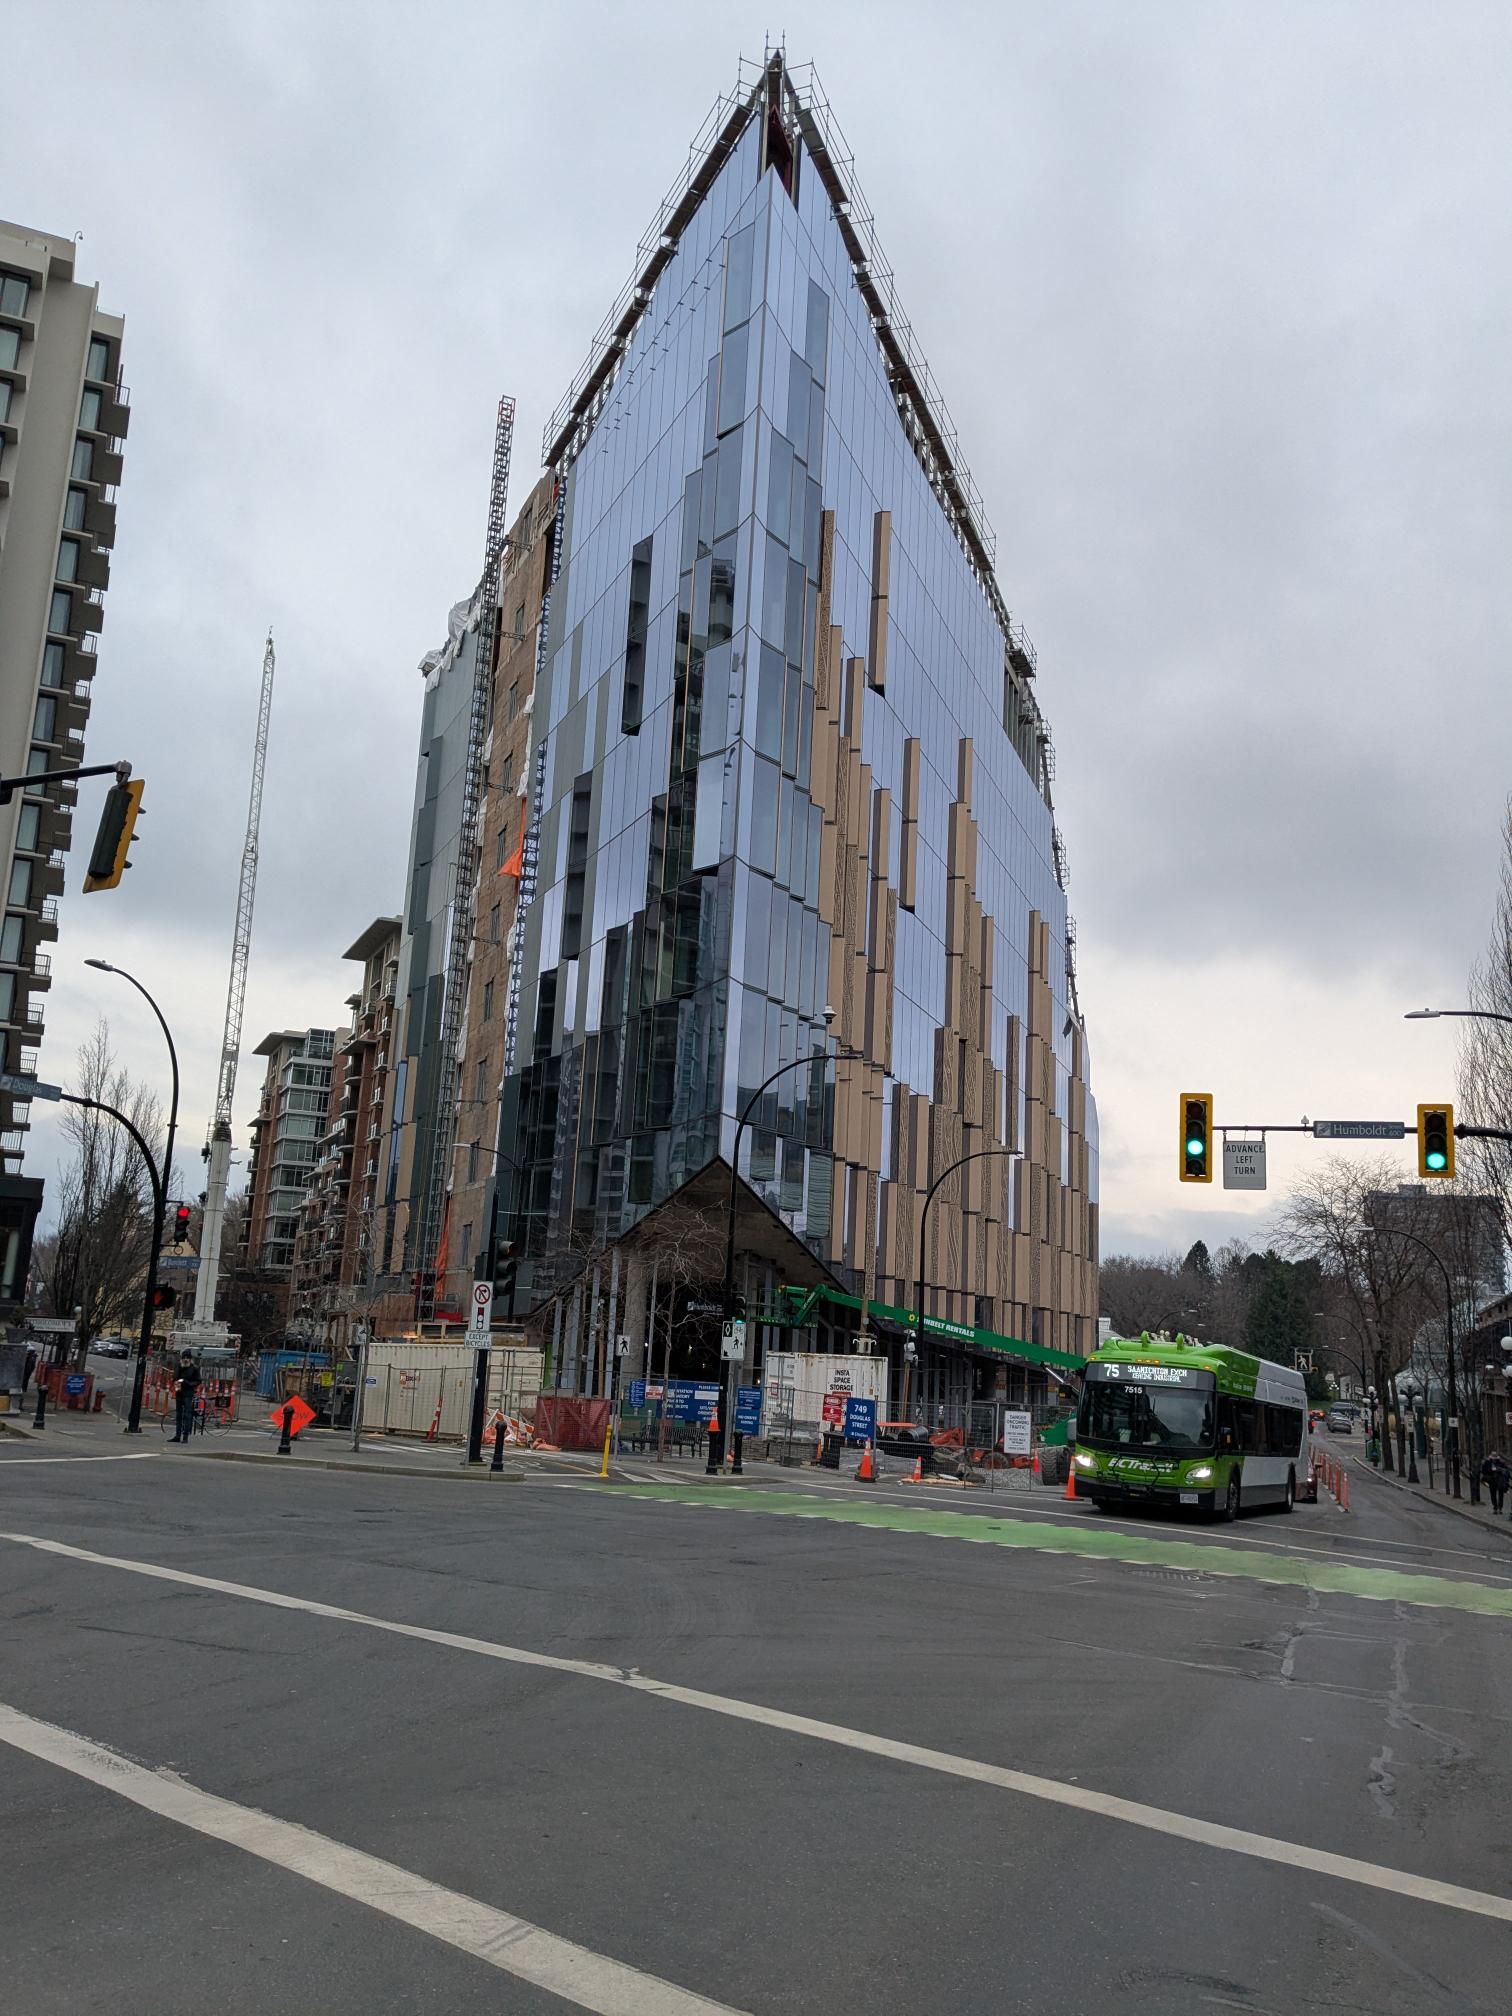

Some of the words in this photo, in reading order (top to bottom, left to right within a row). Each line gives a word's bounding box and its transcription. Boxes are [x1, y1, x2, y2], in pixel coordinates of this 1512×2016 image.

[1333, 1124, 1387, 1136] Humboldt
[1226, 1145, 1263, 1153] ADVANCE
[1236, 1156, 1253, 1164] LEFT
[1234, 1167, 1256, 1175] TURN
[917, 1316, 946, 1329] NBELT
[945, 1324, 975, 1338] RENTALS
[834, 1369, 850, 1377] INSTA
[1103, 1363, 1120, 1378] 75
[1170, 1368, 1187, 1377] EXCH
[829, 1384, 854, 1392] STORAGE
[1124, 1386, 1143, 1394] 7515
[854, 1404, 868, 1414] 749
[849, 1414, 871, 1423] DOUGLAS
[851, 1421, 868, 1430] STREET
